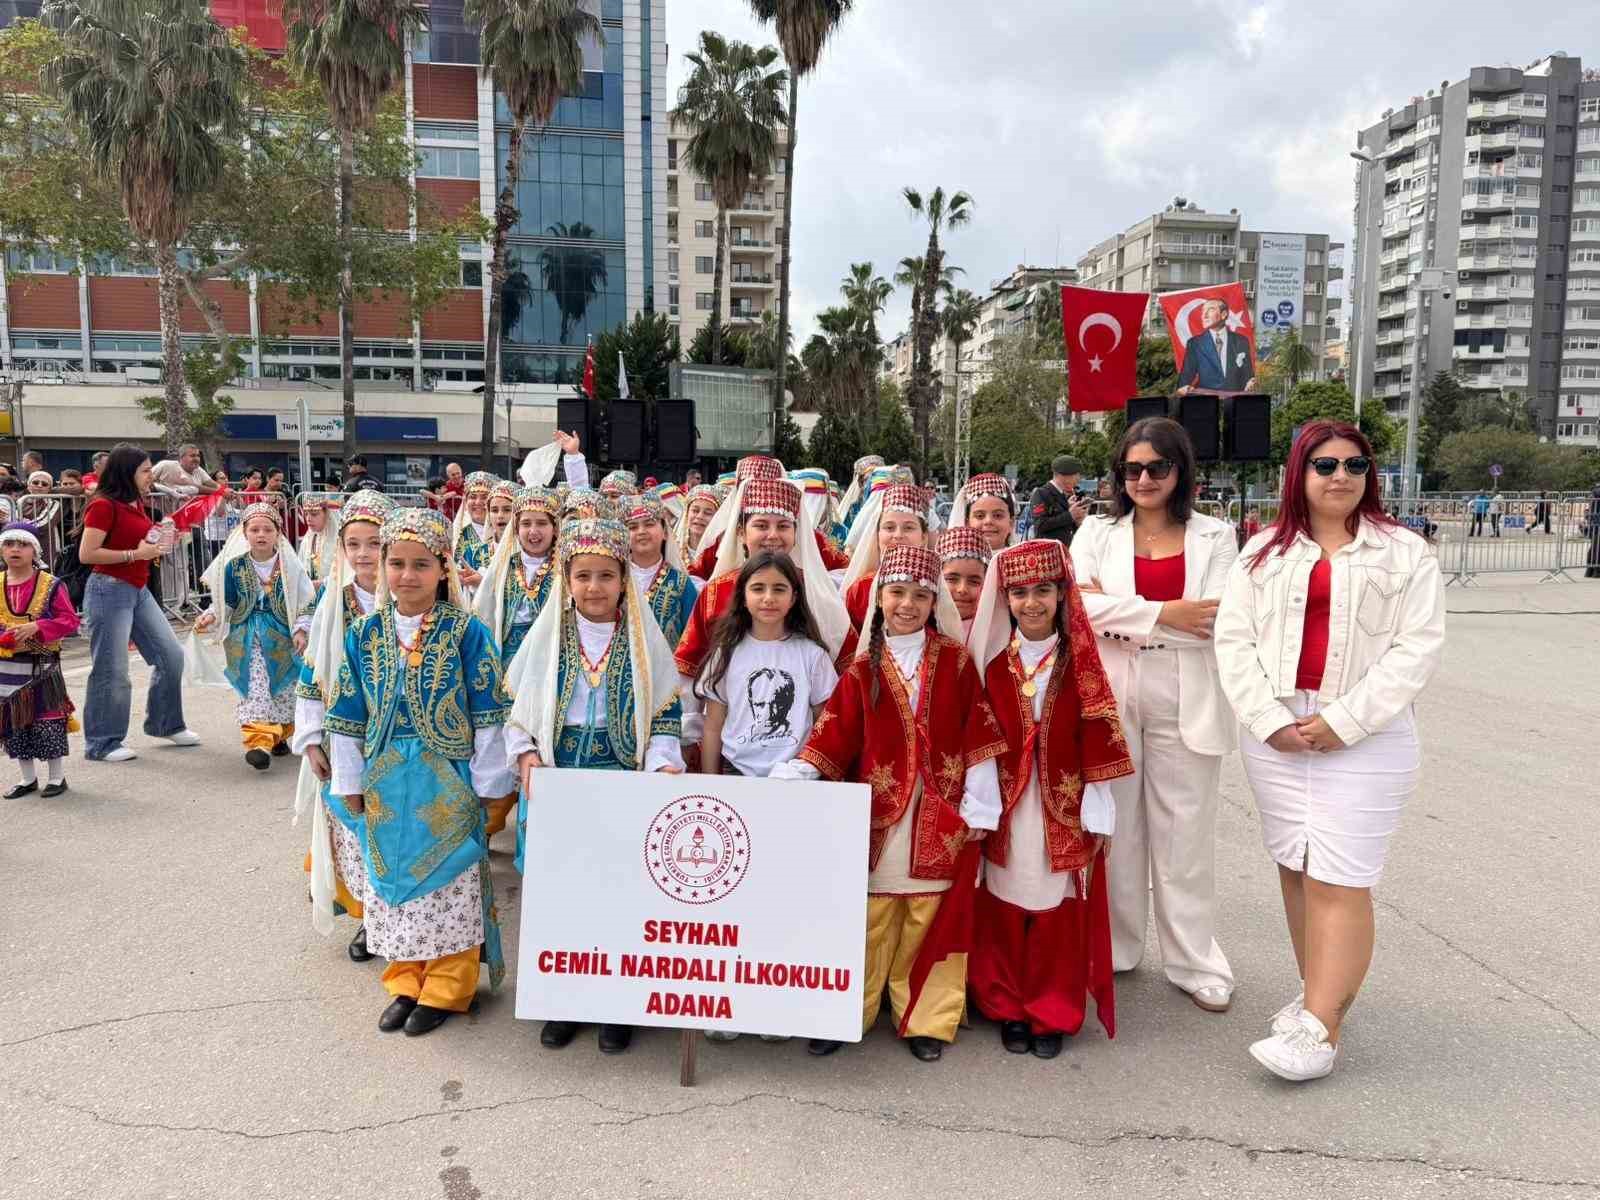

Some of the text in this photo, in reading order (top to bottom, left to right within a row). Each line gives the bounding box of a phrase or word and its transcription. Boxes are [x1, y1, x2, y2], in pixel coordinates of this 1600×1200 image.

[282, 423, 298, 432] Türk
[643, 919, 739, 947] SEYHAN
[538, 947, 851, 992] CEMİL NARDALI İLKOKULU
[646, 991, 732, 1019] ADANA
